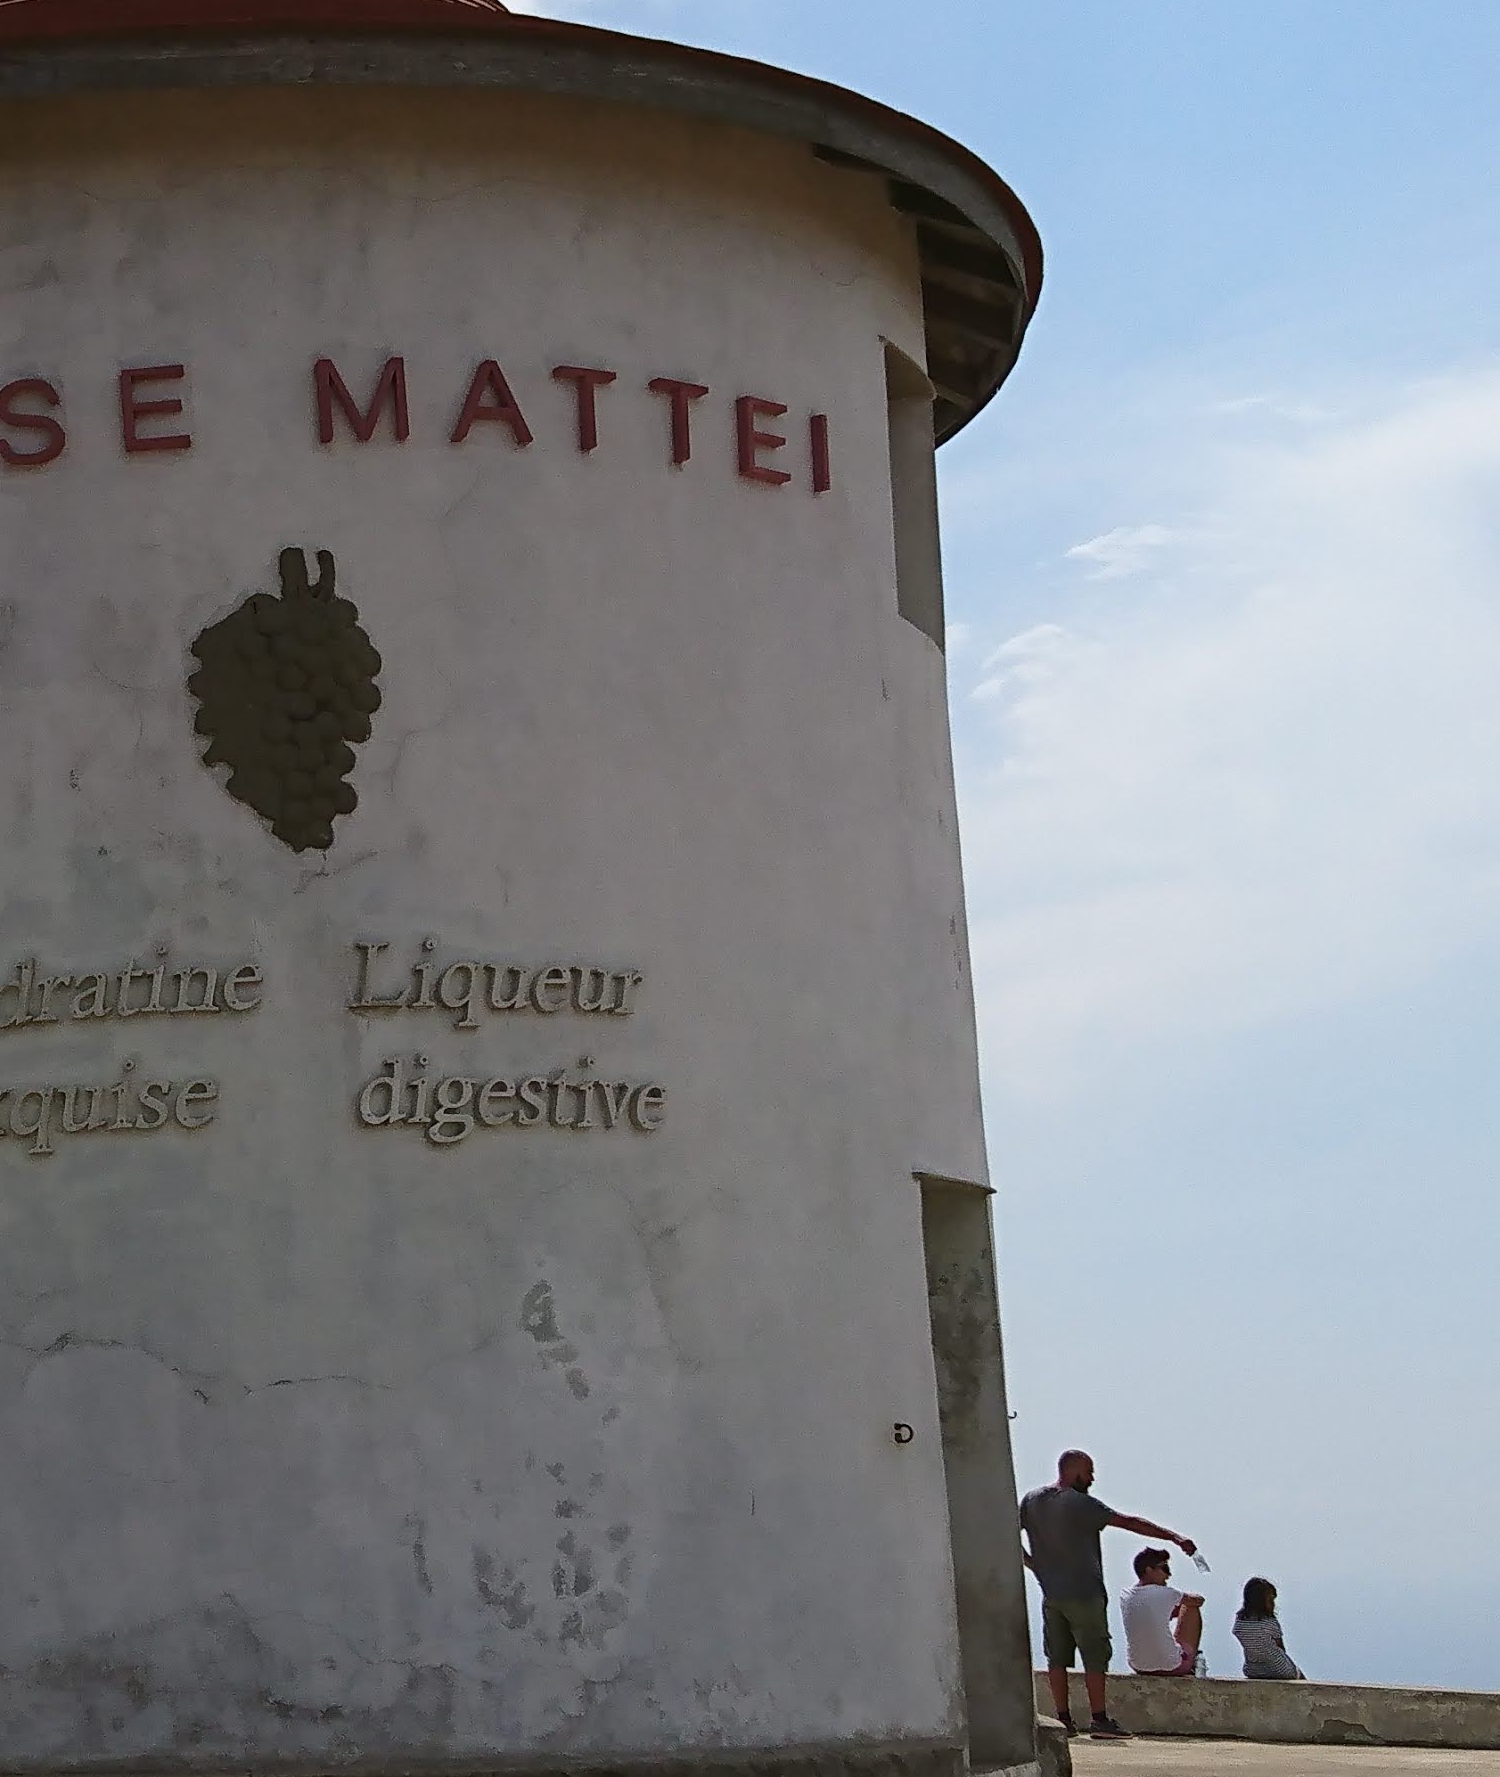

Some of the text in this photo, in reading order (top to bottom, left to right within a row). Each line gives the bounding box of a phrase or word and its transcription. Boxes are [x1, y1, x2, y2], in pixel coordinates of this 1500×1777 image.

[313, 355, 831, 494] MATTEI
[345, 935, 644, 1029] Liqueur
[354, 1052, 669, 1151] digestive
